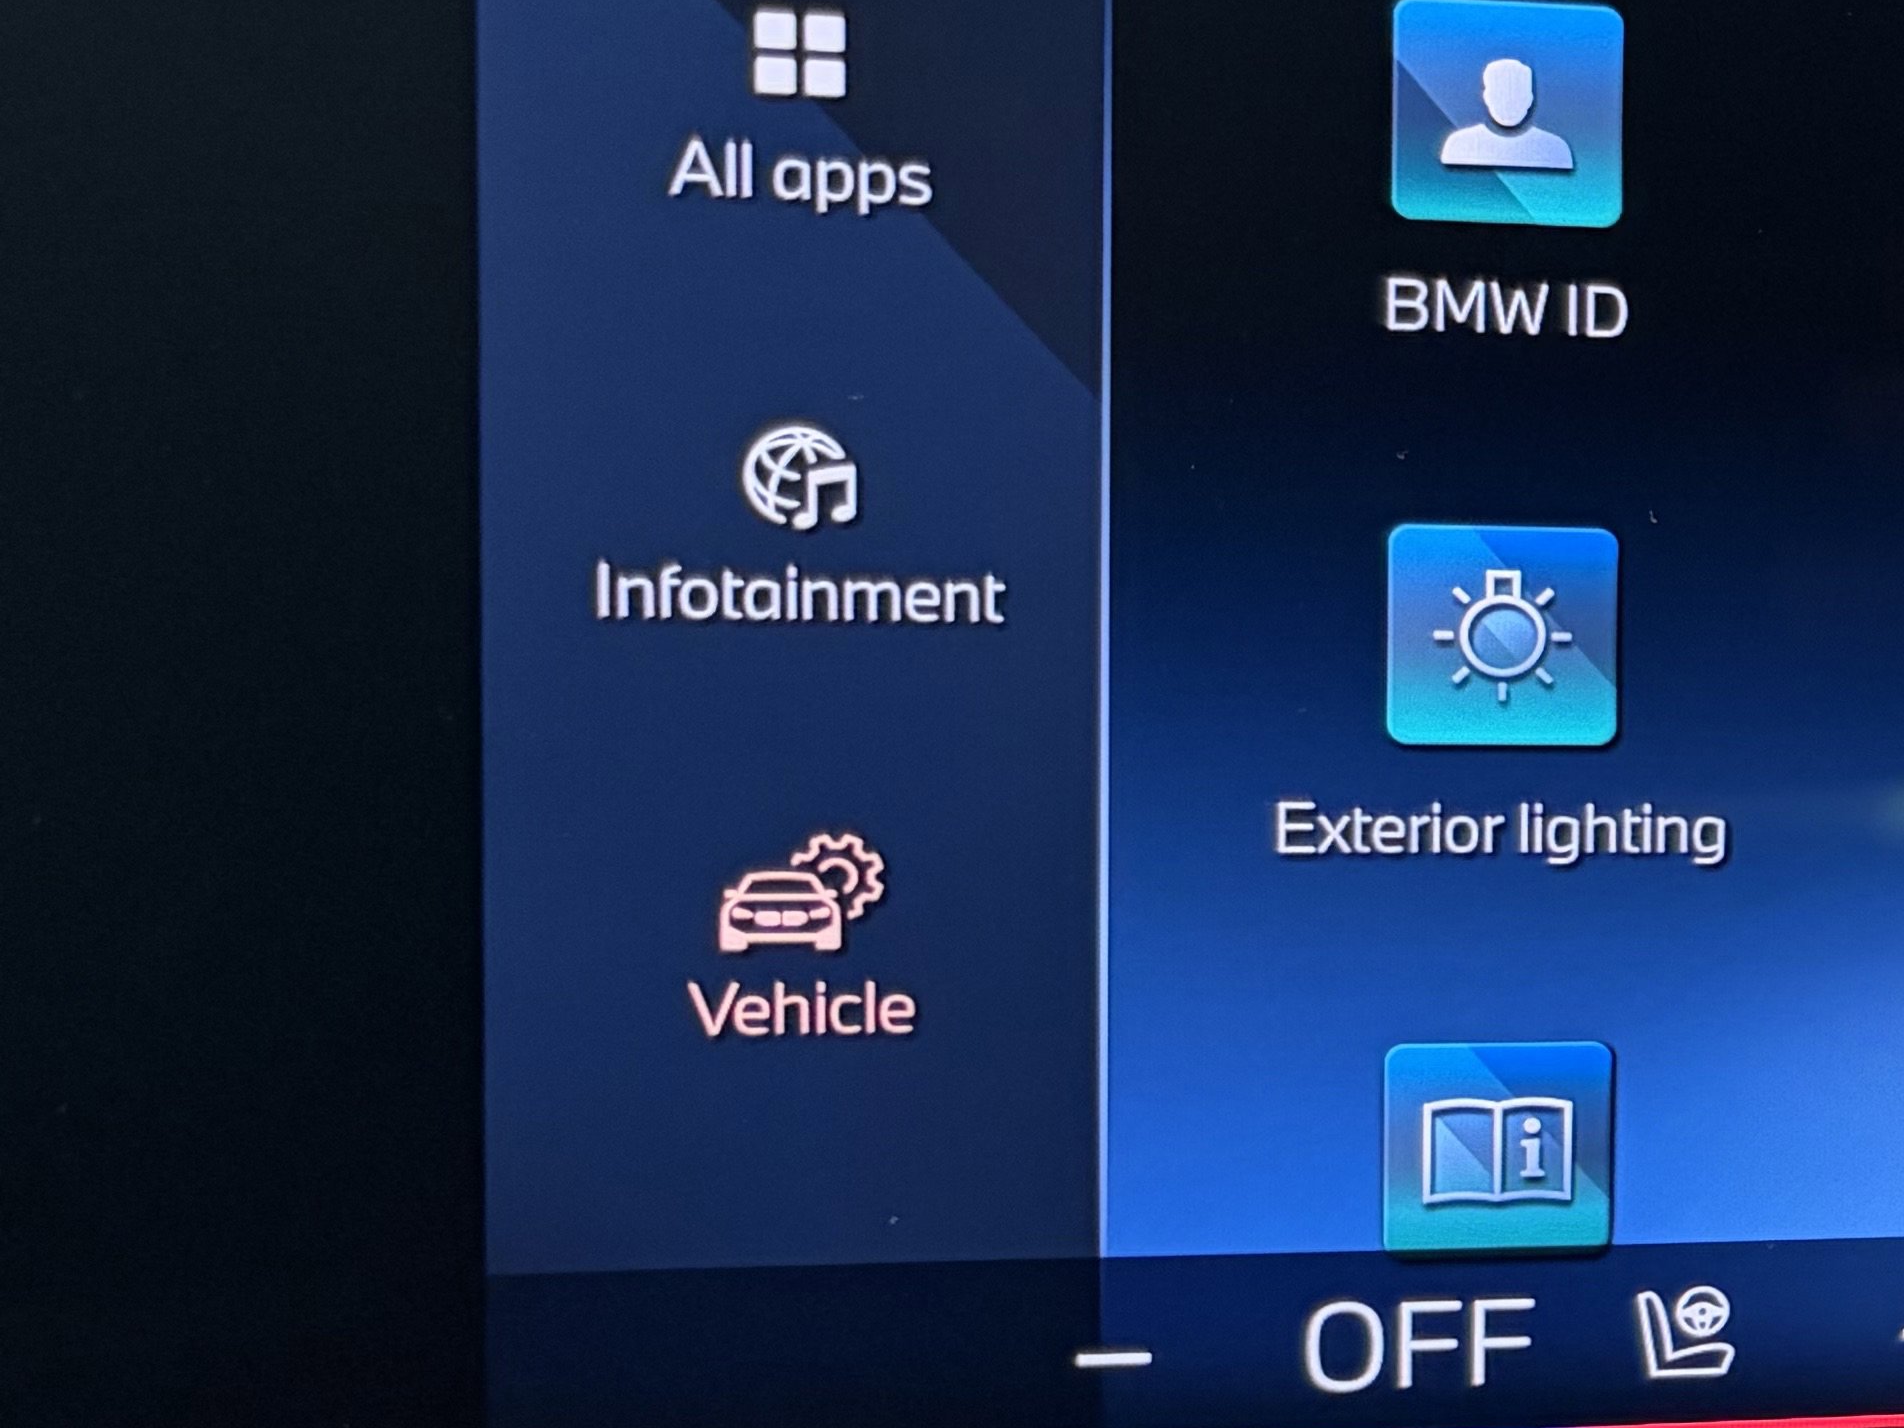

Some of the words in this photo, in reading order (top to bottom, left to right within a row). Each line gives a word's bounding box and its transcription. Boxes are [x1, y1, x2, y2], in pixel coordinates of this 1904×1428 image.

[667, 135, 754, 199] All
[771, 156, 933, 216] apps
[1384, 275, 1551, 337] BMW
[1566, 282, 1629, 339] ID
[595, 559, 1007, 625] Infotainment
[1274, 799, 1507, 855] Exterior
[1518, 801, 1727, 866] lighting
[686, 978, 917, 1038] Vehicle
[1518, 1115, 1546, 1178] i
[1303, 1296, 1537, 1394] OFF
